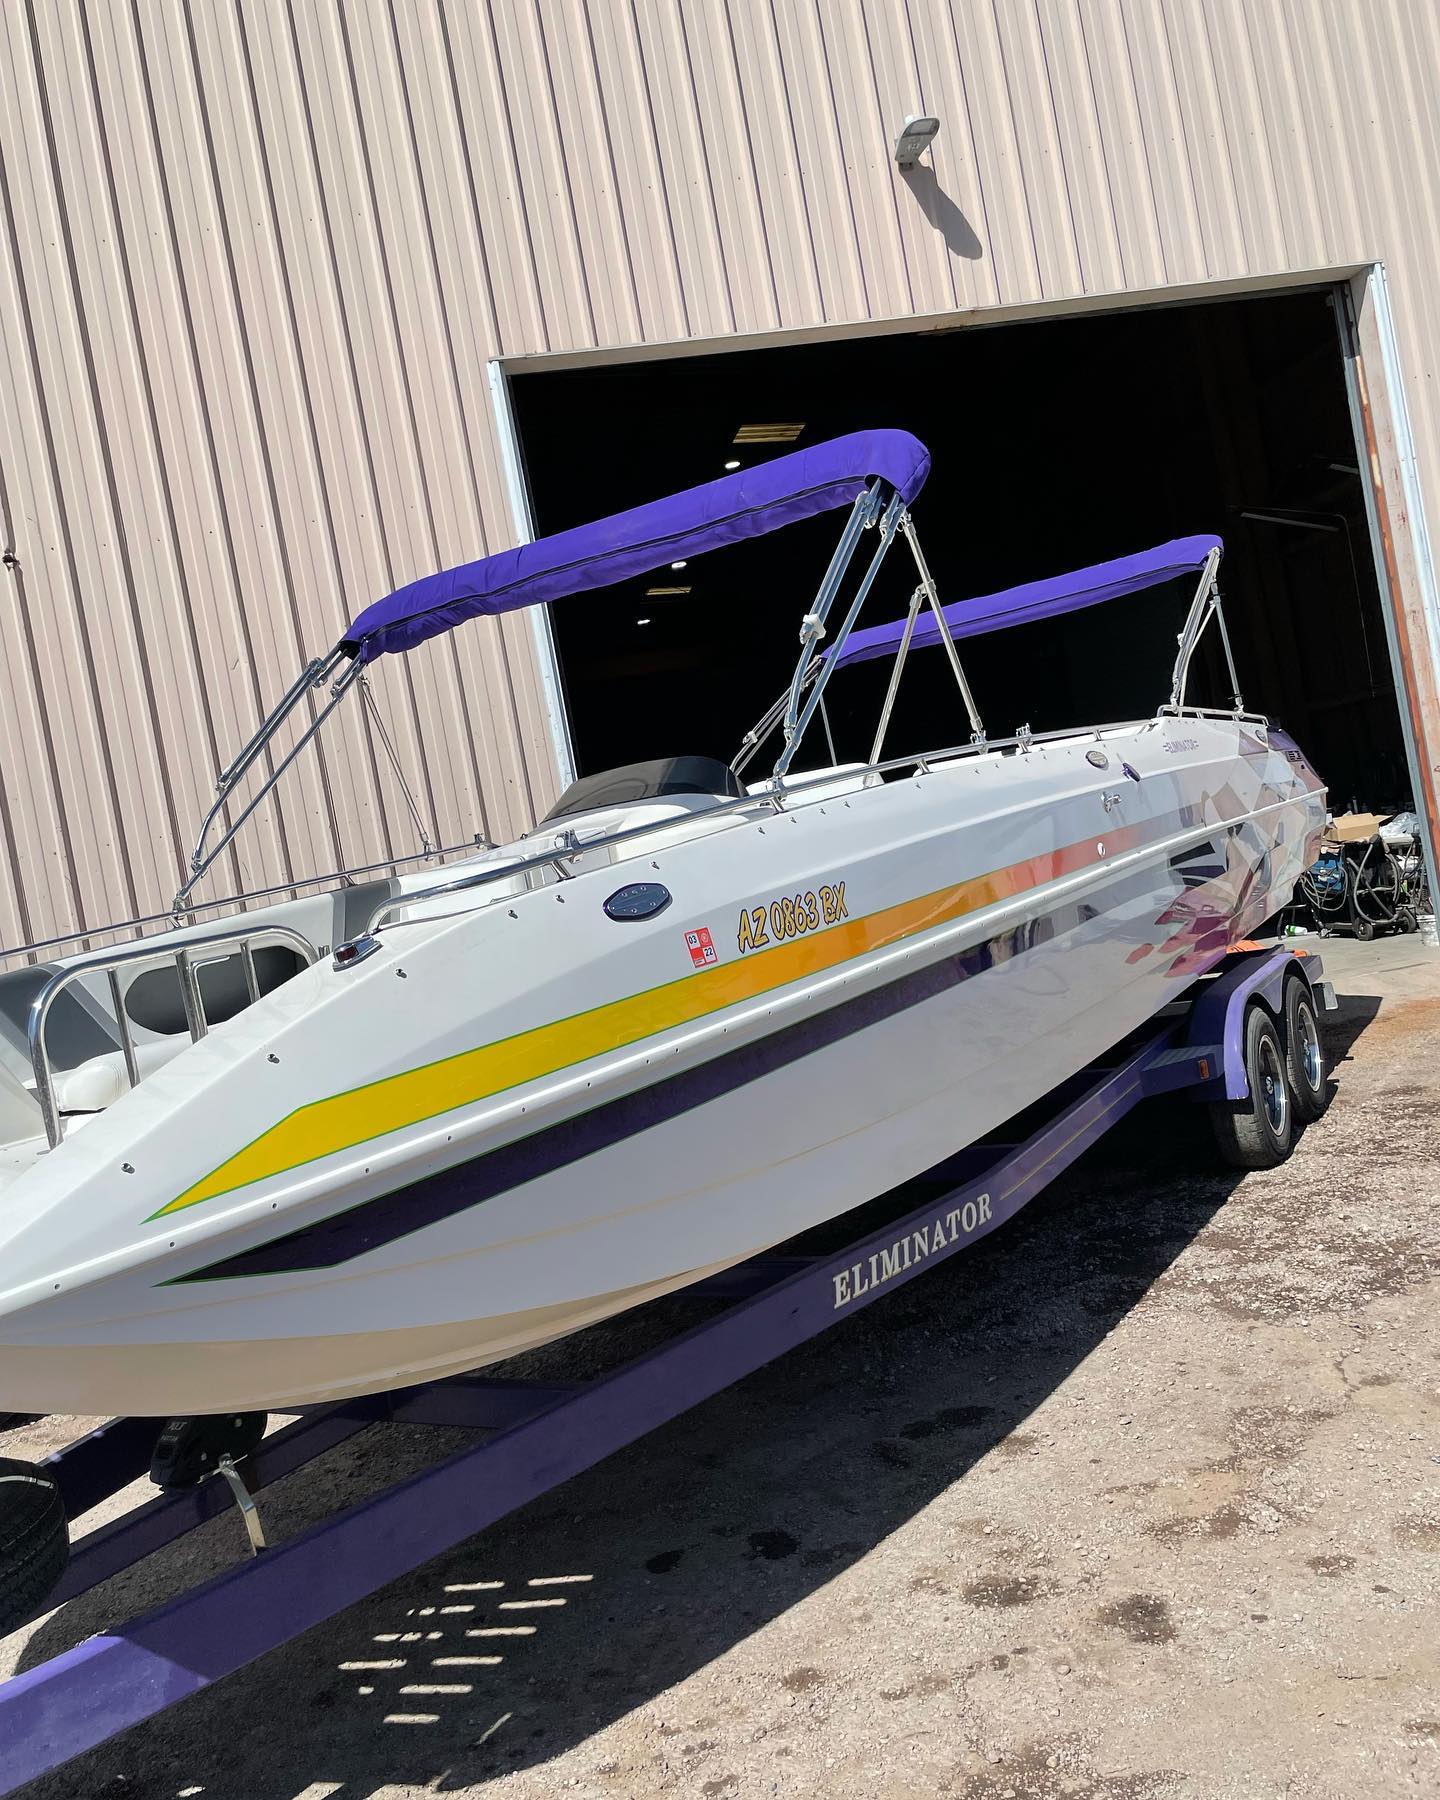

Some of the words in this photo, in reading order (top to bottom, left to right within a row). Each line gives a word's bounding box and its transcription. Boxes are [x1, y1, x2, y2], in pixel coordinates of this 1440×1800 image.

[737, 906, 770, 954] AZ
[769, 891, 819, 940] 0863
[819, 881, 849, 925] BX
[688, 935, 698, 944] 03
[704, 947, 713, 957] 22
[832, 1193, 993, 1309] ELIMINATOR
